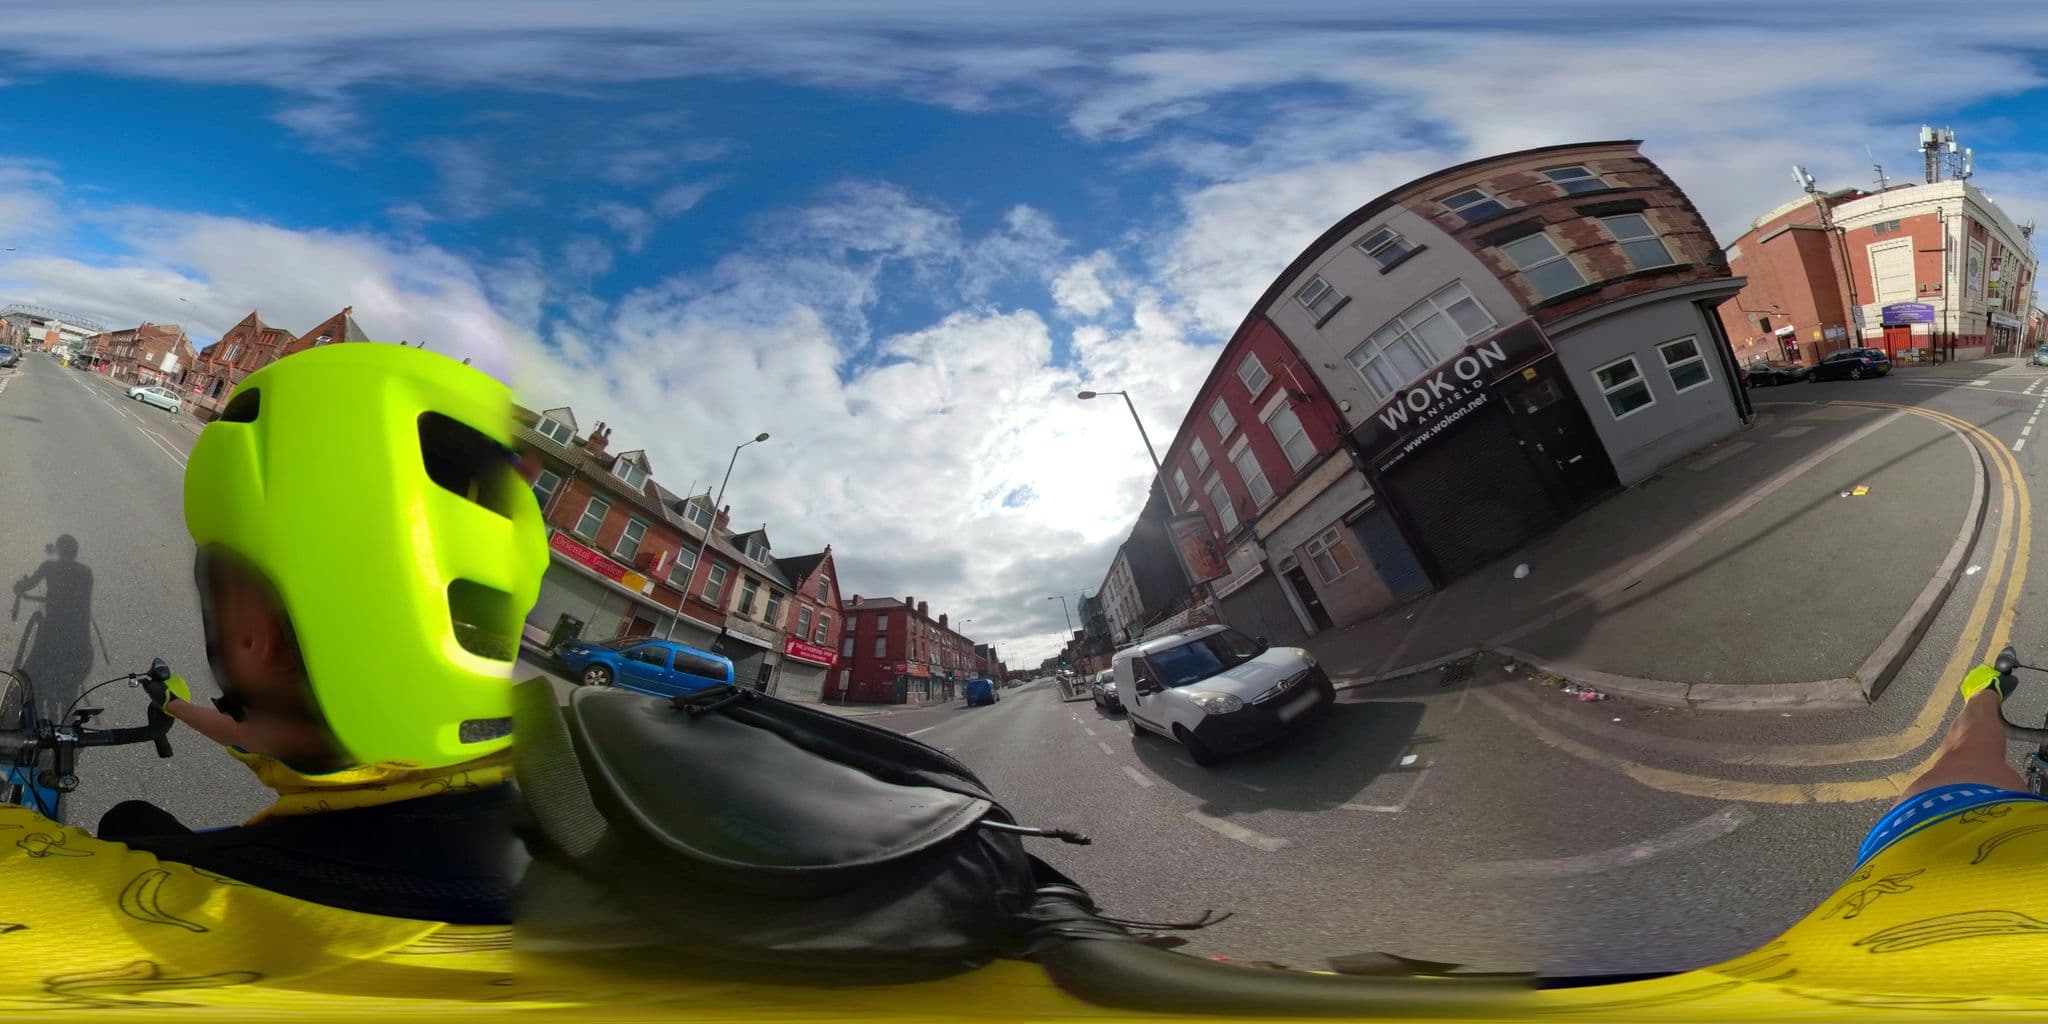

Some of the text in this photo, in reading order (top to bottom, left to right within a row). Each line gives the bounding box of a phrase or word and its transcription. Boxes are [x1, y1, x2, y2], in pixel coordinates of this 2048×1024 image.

[1379, 341, 1507, 431] WOK ON
[1418, 379, 1483, 424] ANFIELD
[1404, 393, 1488, 453] www.wokon.net
[556, 535, 623, 577] Oriental Garden
